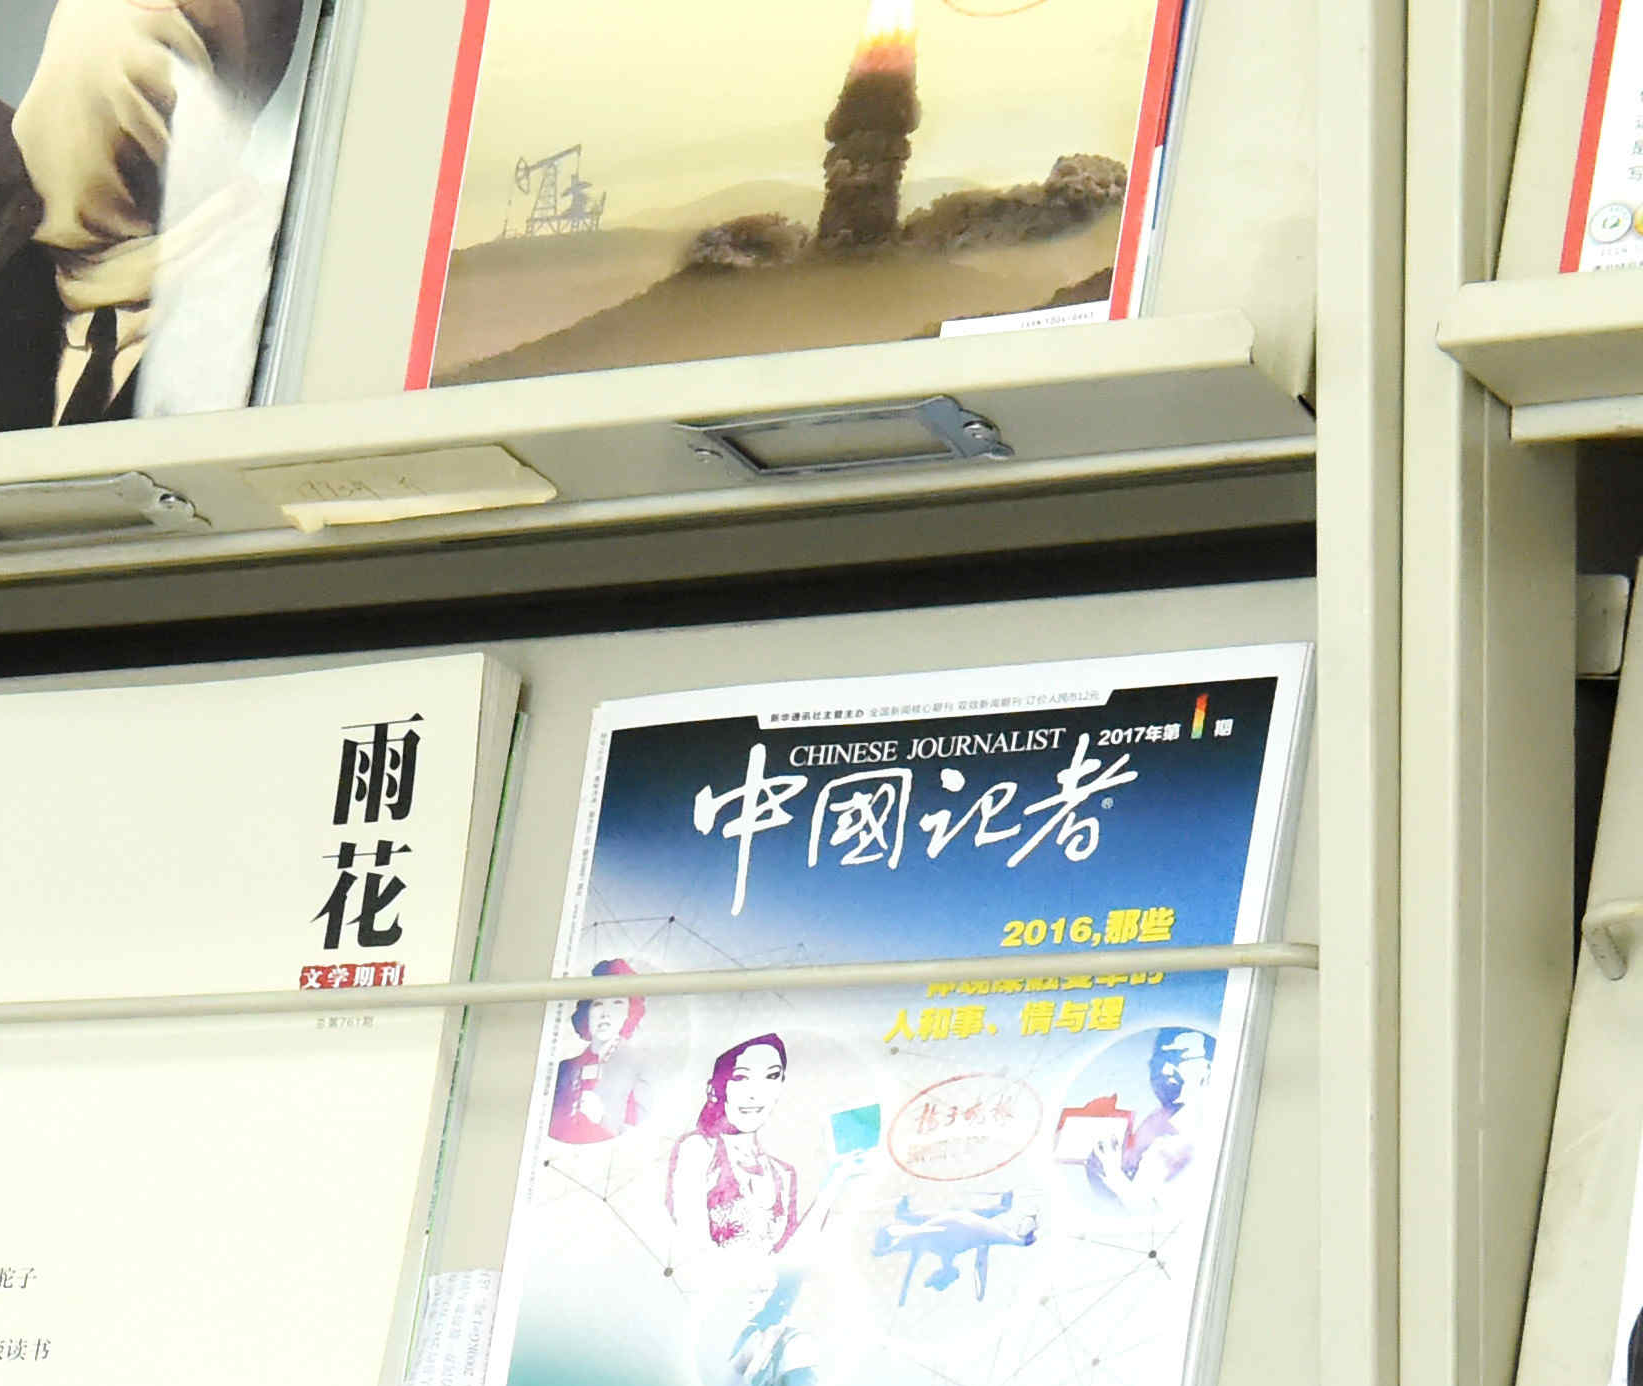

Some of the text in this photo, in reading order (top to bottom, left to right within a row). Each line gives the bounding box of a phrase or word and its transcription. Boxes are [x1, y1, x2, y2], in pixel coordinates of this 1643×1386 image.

[788, 726, 1067, 769] CHINESE JOURNALIST
[310, 712, 426, 950] 雨花
[302, 964, 404, 990] 文学期刊
[883, 997, 1126, 1044] 人和事、情与理
